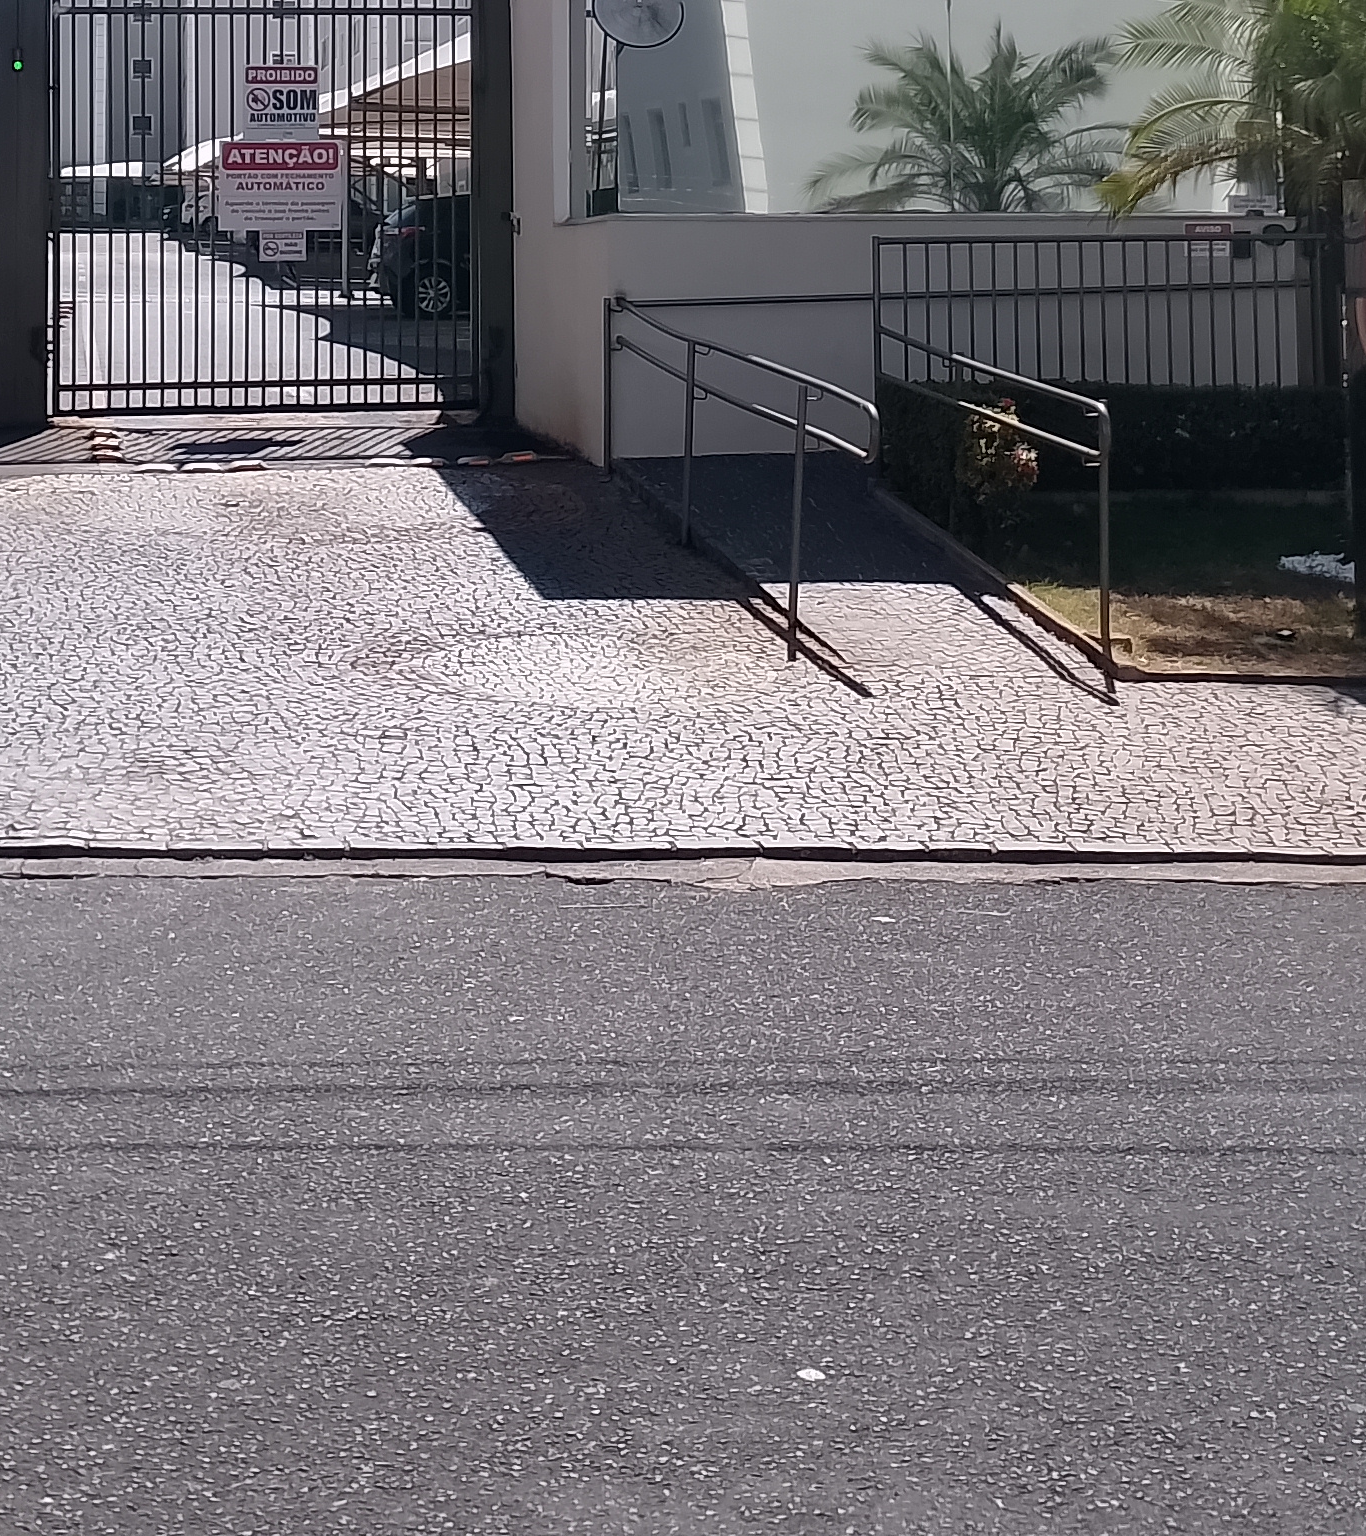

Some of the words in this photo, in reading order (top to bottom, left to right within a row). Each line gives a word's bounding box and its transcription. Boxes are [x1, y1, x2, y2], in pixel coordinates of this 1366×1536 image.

[247, 69, 315, 81] PROIBIDO
[272, 89, 317, 110] SOM
[249, 112, 316, 123] AUTOMOTIVO
[227, 145, 334, 167] ATENÇÃO!
[236, 180, 325, 191] AUTOMÁTICO
